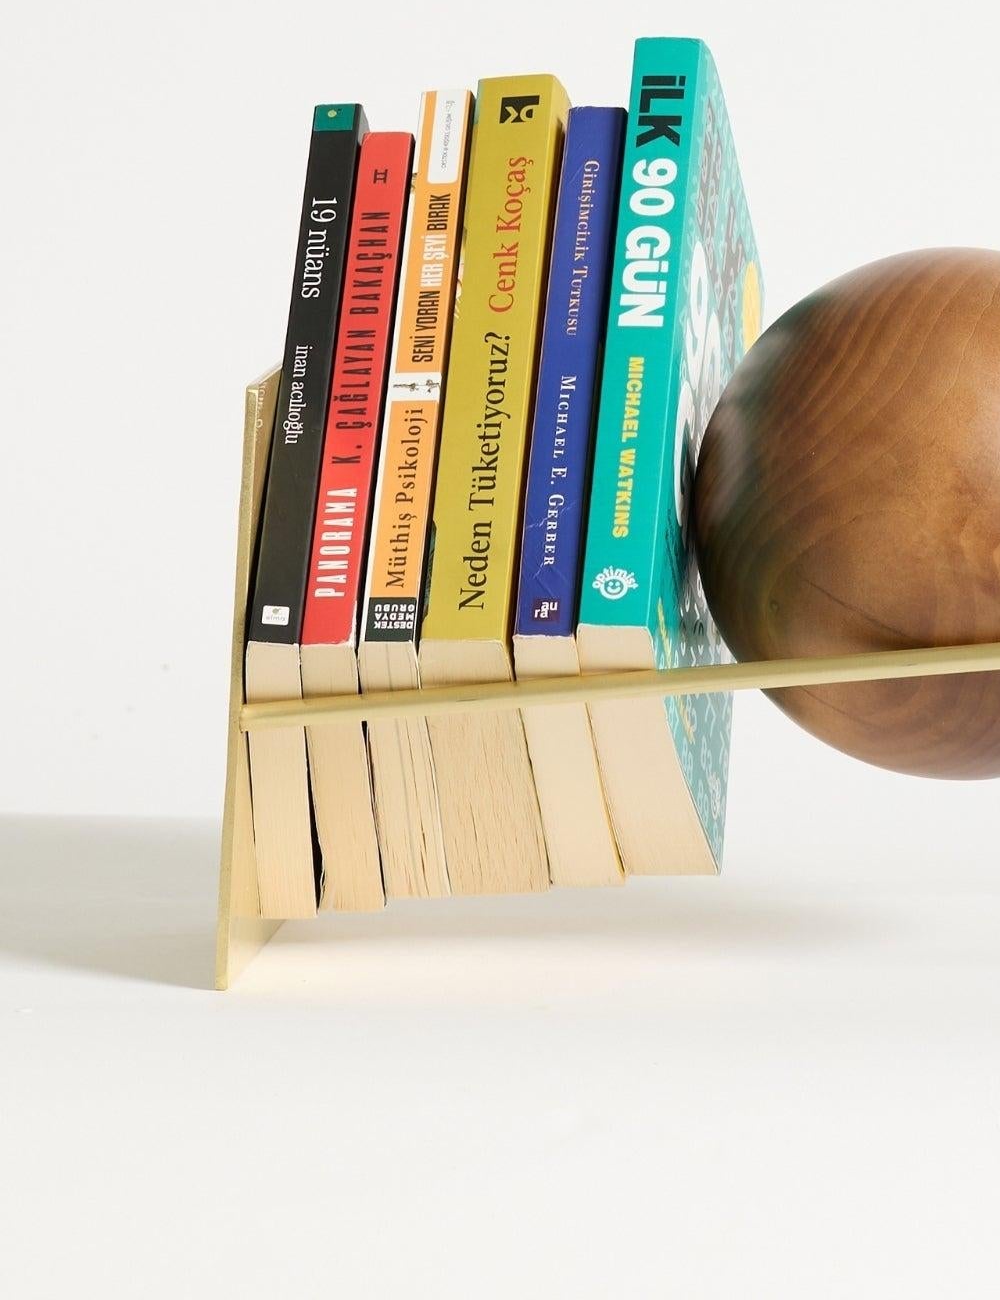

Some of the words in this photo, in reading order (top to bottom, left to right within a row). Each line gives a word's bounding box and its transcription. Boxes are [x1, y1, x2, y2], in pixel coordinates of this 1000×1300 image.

[310, 197, 338, 223] 19
[373, 169, 388, 184] II
[427, 193, 451, 231] BIRAK
[496, 156, 534, 232] Koçaş
[629, 157, 678, 217] 90
[301, 229, 330, 300] nüans
[349, 211, 393, 315] BAKAÇHAN
[420, 262, 443, 288] HER
[421, 233, 449, 261] ŞEYİ
[488, 241, 520, 313] Cenk
[617, 225, 671, 328] GÜN
[415, 290, 441, 333] YORAN
[292, 345, 313, 378] inan
[333, 329, 376, 430] ÇAĞLAYAN
[409, 335, 436, 363] SENİ
[283, 382, 307, 444] acılıoğlu
[468, 331, 511, 511] Tüketiyoruz?
[553, 375, 577, 459] MICHAEL
[621, 356, 645, 443] MICHAEL
[331, 445, 363, 464] K.
[395, 408, 428, 504] Psikoloji
[550, 467, 568, 485] E.
[612, 448, 636, 538] WATKINS
[314, 487, 357, 598] PANORAMA
[385, 512, 418, 588] Müthiş
[543, 493, 566, 566] GERBER
[458, 521, 493, 611] Neden
[373, 621, 413, 629] DESTEK
[374, 612, 414, 620] MEDYA
